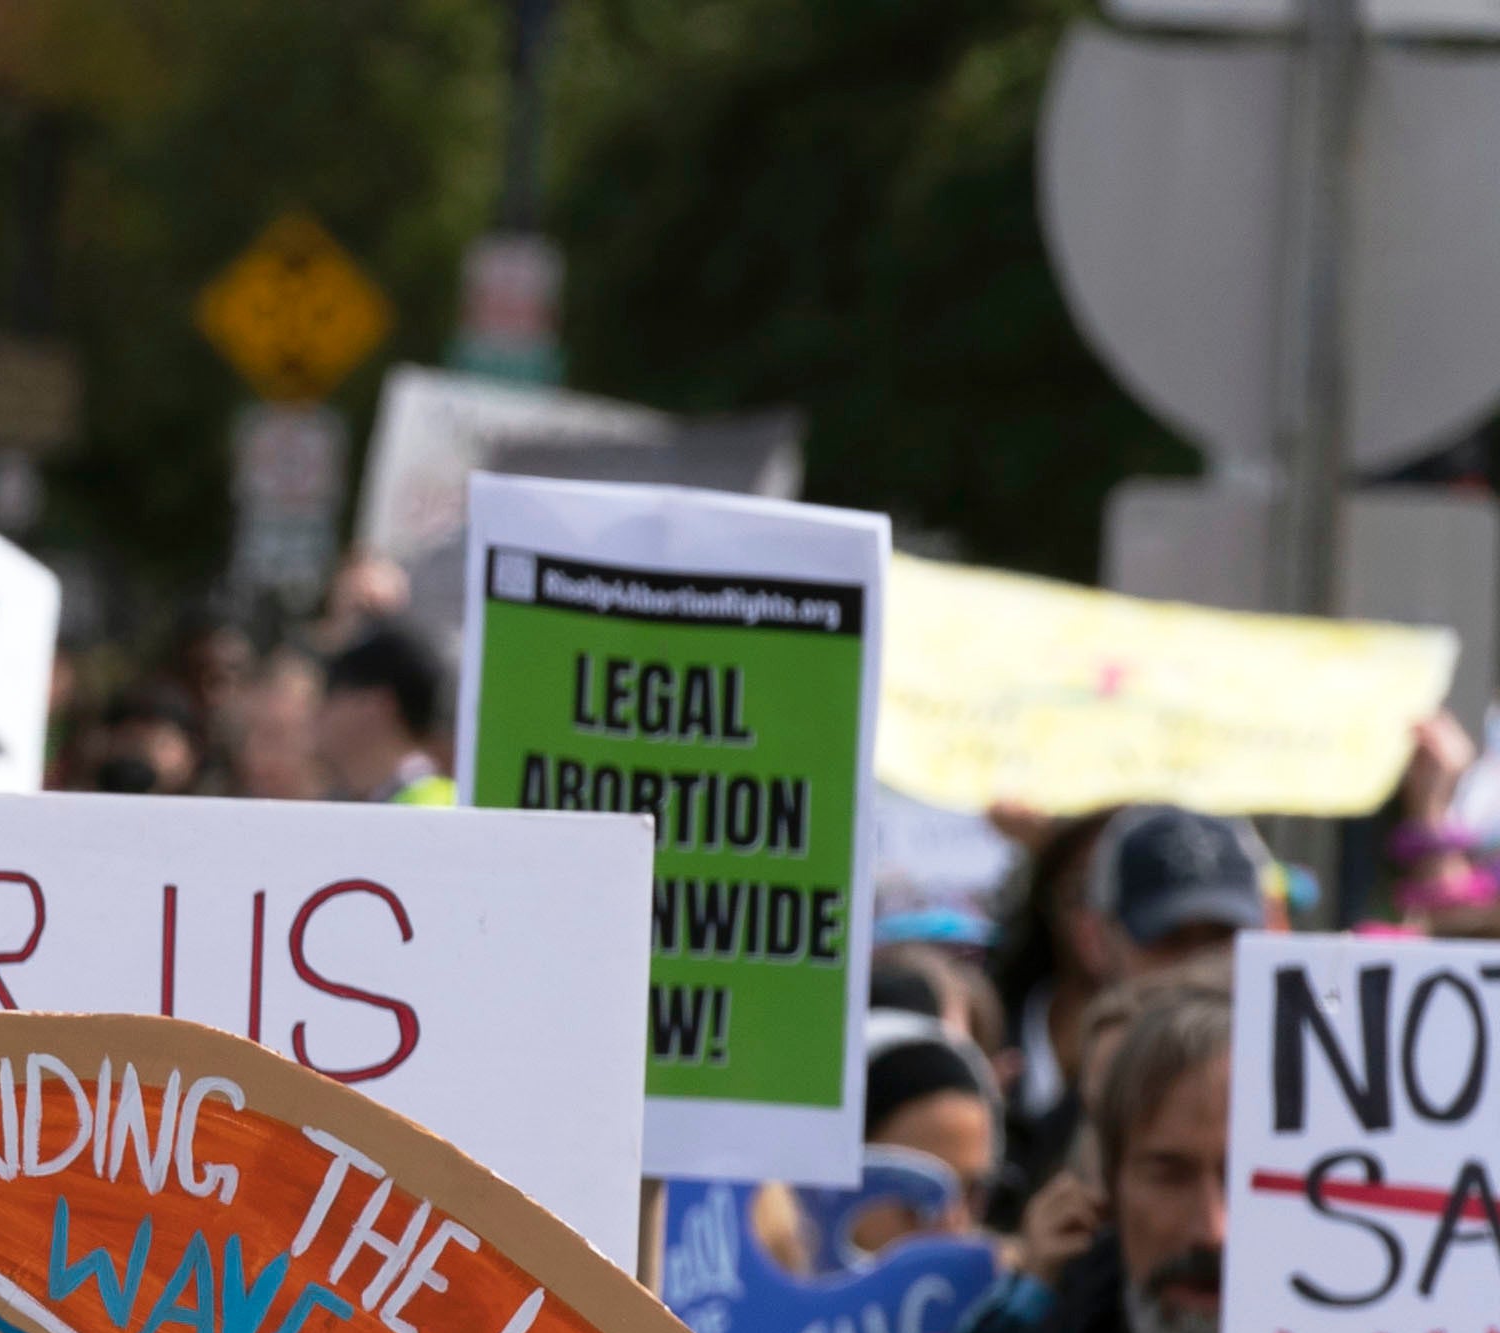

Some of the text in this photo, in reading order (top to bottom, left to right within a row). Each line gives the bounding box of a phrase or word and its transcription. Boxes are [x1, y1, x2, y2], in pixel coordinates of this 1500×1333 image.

[572, 651, 756, 748] LEGAL
[519, 752, 810, 858] ABORTION
[161, 877, 421, 1083] US
[1272, 964, 1500, 1133] NO
